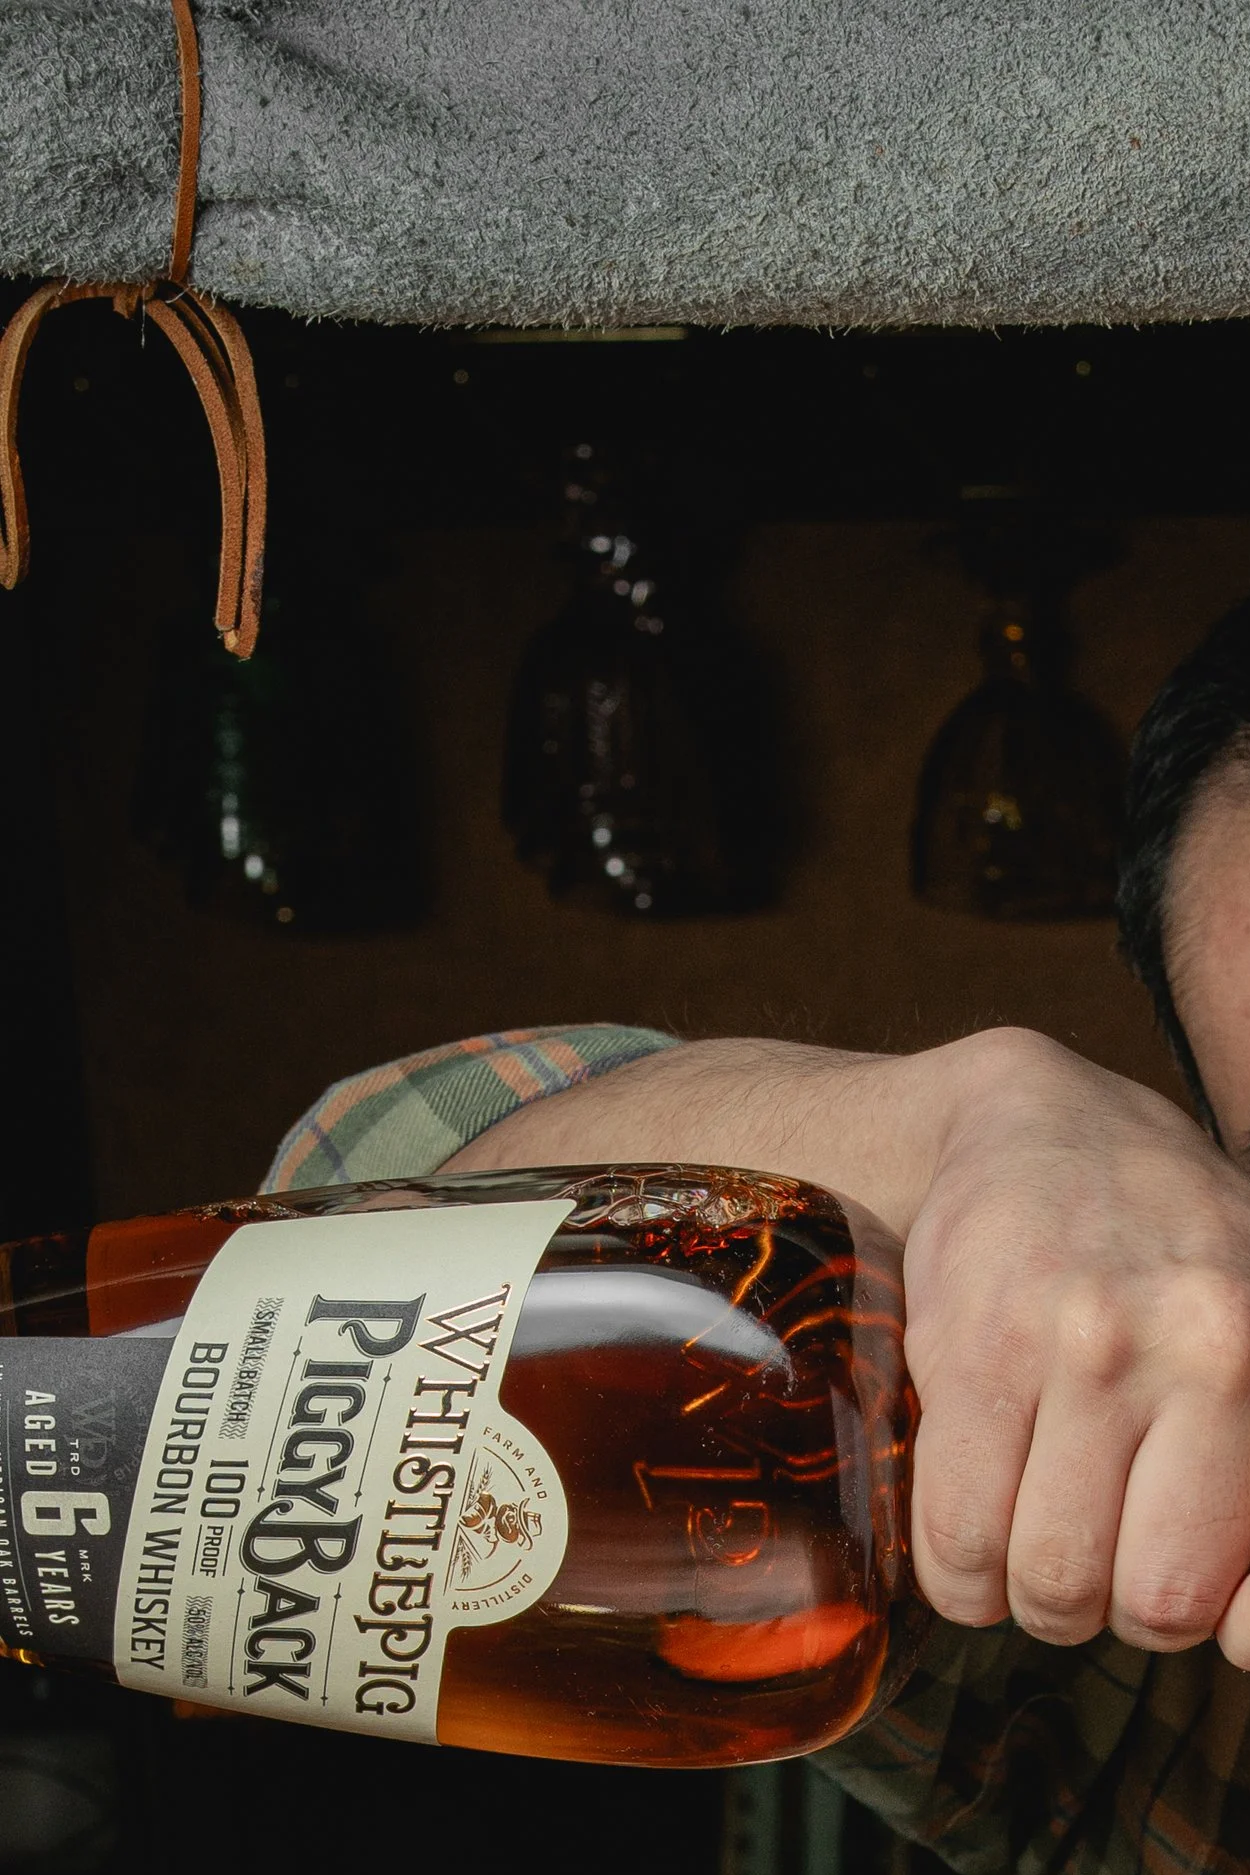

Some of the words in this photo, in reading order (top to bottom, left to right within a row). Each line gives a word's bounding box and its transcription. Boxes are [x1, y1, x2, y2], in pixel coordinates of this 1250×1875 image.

[243, 1310, 276, 1365] SMALL
[226, 1369, 259, 1423] BATCH
[24, 1389, 58, 1476] AGED
[150, 1341, 230, 1515] BOURBON
[483, 1426, 525, 1461] FARM
[69, 1438, 81, 1477] TRD
[78, 1549, 92, 1583] MRK
[200, 1459, 250, 1519] 100
[241, 1292, 427, 1700] PIGGYBACK
[354, 1283, 511, 1715] WHISTLEPIG
[524, 1466, 548, 1500] AND
[21, 1491, 111, 1537] 6
[199, 1525, 225, 1578] PROOF
[3, 1578, 34, 1637] BARRELS
[34, 1549, 80, 1625] YEARS
[131, 1527, 183, 1671] WHISKEY
[451, 1572, 534, 1611] DISTILLERY
